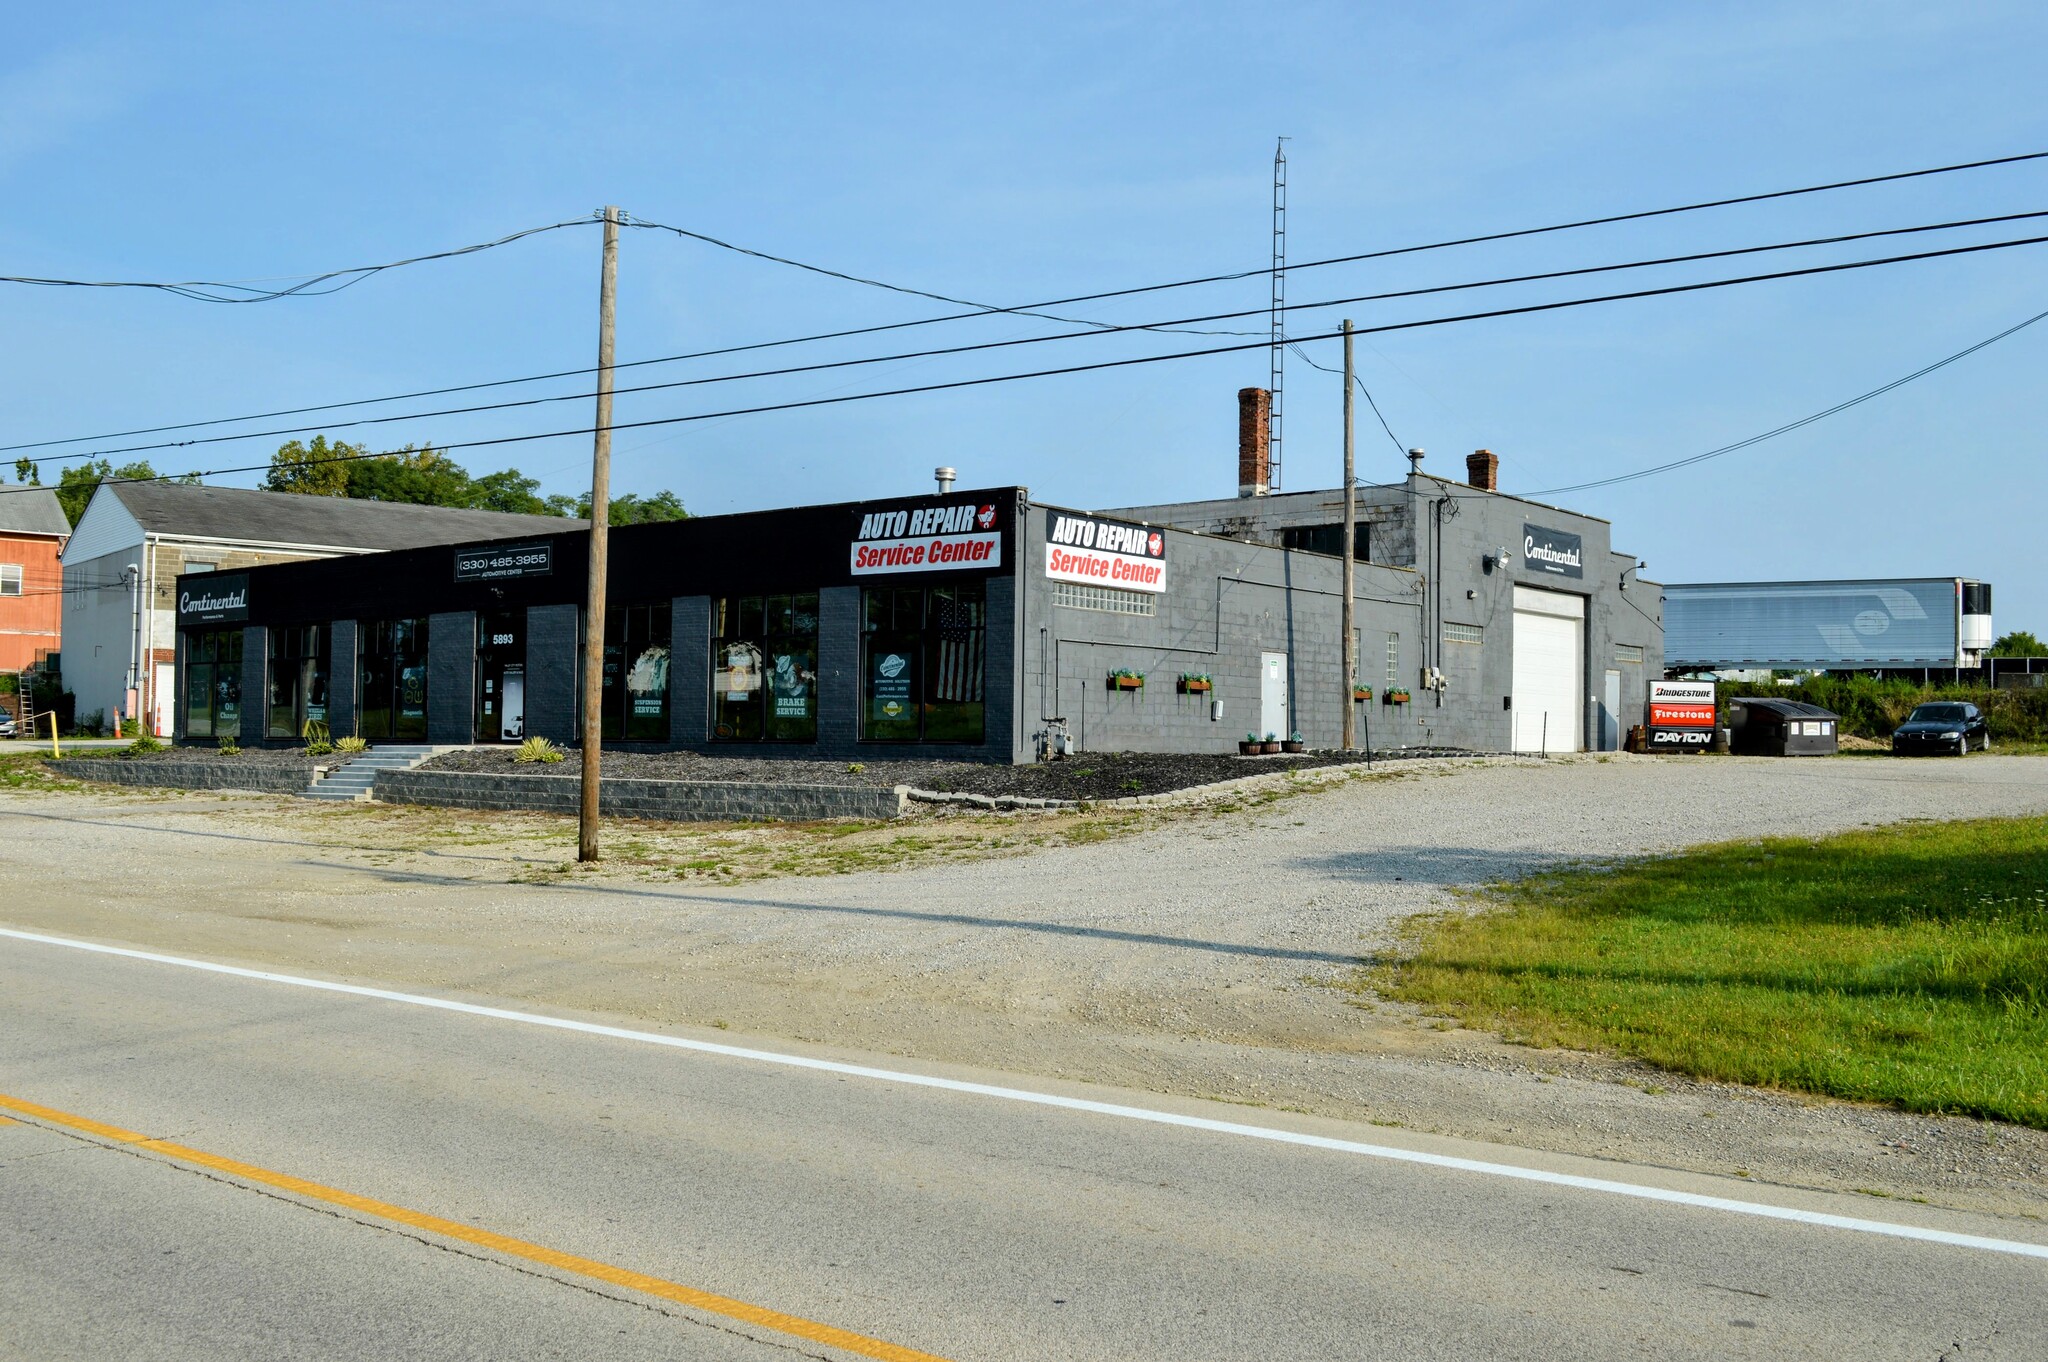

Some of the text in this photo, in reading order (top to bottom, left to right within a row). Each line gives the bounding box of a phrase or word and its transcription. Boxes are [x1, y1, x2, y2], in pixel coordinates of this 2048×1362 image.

[858, 505, 976, 540] AUTO REPAIR
[1051, 516, 1149, 555] AUTO REPAIR
[855, 540, 995, 568] Service Center
[1524, 535, 1582, 567] Continental
[459, 559, 489, 571] (330)
[1050, 548, 1162, 584] Service Center
[180, 588, 247, 614] Continental
[493, 633, 514, 645] 5893
[1655, 688, 1712, 698] BRIDGESTONE
[224, 702, 234, 711] Oil
[777, 698, 805, 706] BRAKE
[220, 711, 238, 720] Change
[634, 706, 660, 714] SERVICE
[776, 707, 806, 715] SERVICE
[1654, 709, 1712, 719] Firestone
[1653, 732, 1712, 743] DAYTON
